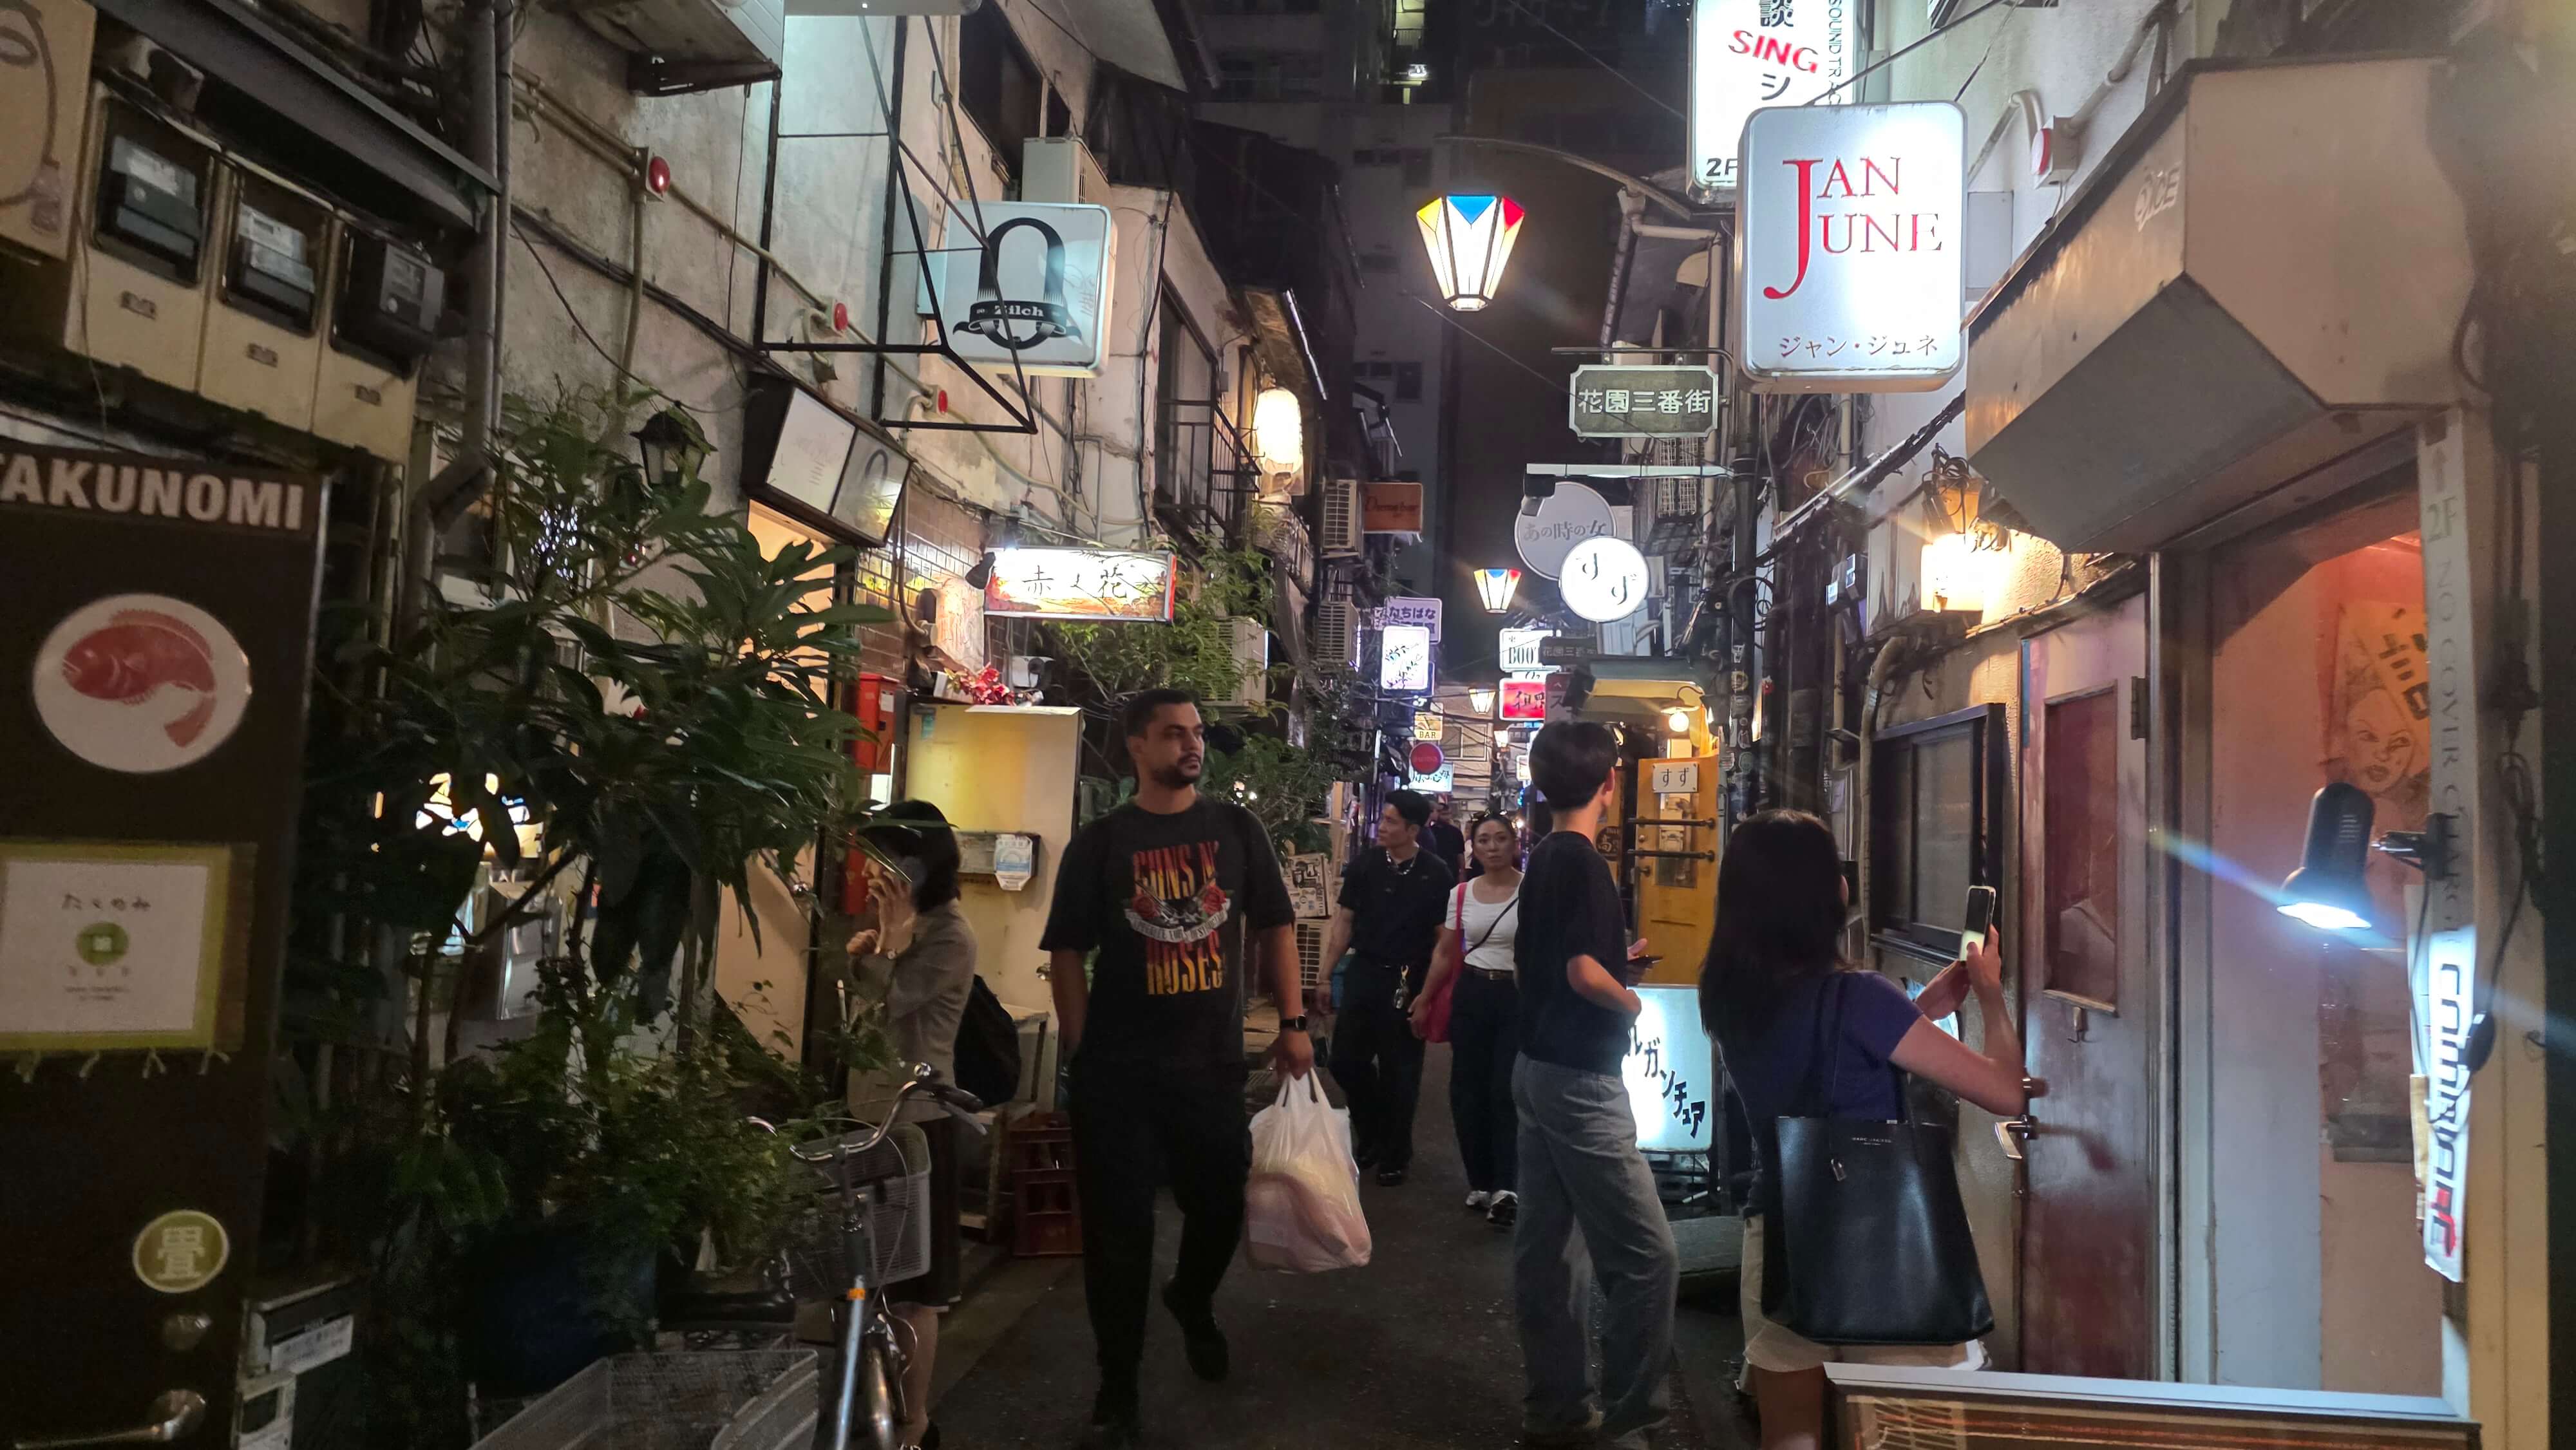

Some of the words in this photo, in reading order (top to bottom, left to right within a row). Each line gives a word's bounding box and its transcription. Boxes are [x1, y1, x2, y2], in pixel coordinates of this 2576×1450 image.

[1728, 30, 1819, 74] SING
[1779, 335, 1938, 358] ジャン・ジュネ
[1578, 388, 1711, 414] 花園三番街
[0, 453, 304, 530] AKUNOMI
[1508, 646, 1537, 664] BOO
[1660, 767, 1689, 787] すず
